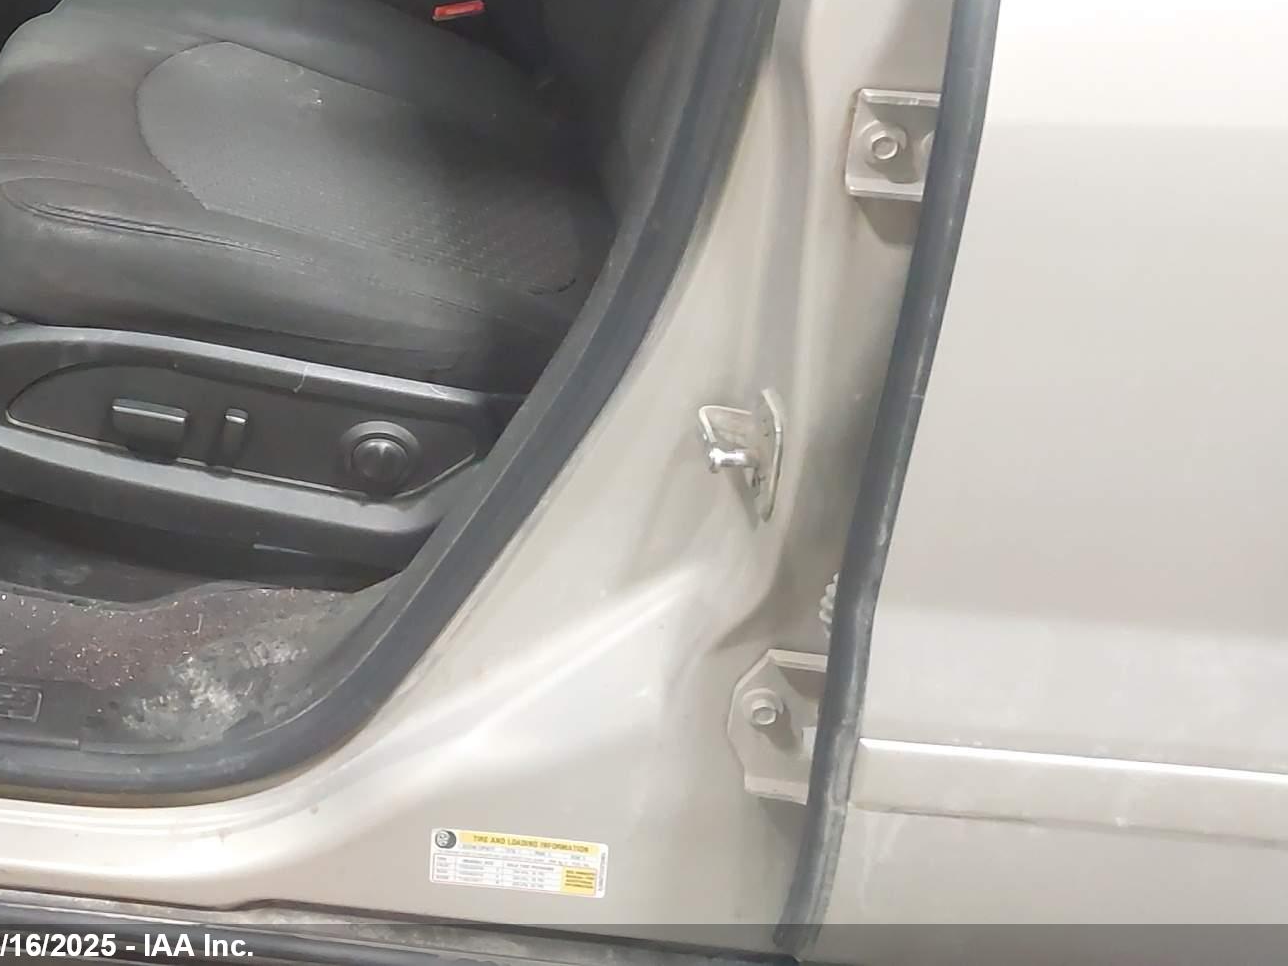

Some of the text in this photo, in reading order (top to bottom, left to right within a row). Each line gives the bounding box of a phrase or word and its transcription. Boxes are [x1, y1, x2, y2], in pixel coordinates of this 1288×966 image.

[473, 835, 489, 843] TIRE
[491, 836, 506, 845] AND
[507, 837, 538, 848] LOADING
[540, 841, 589, 854] INFORMATION
